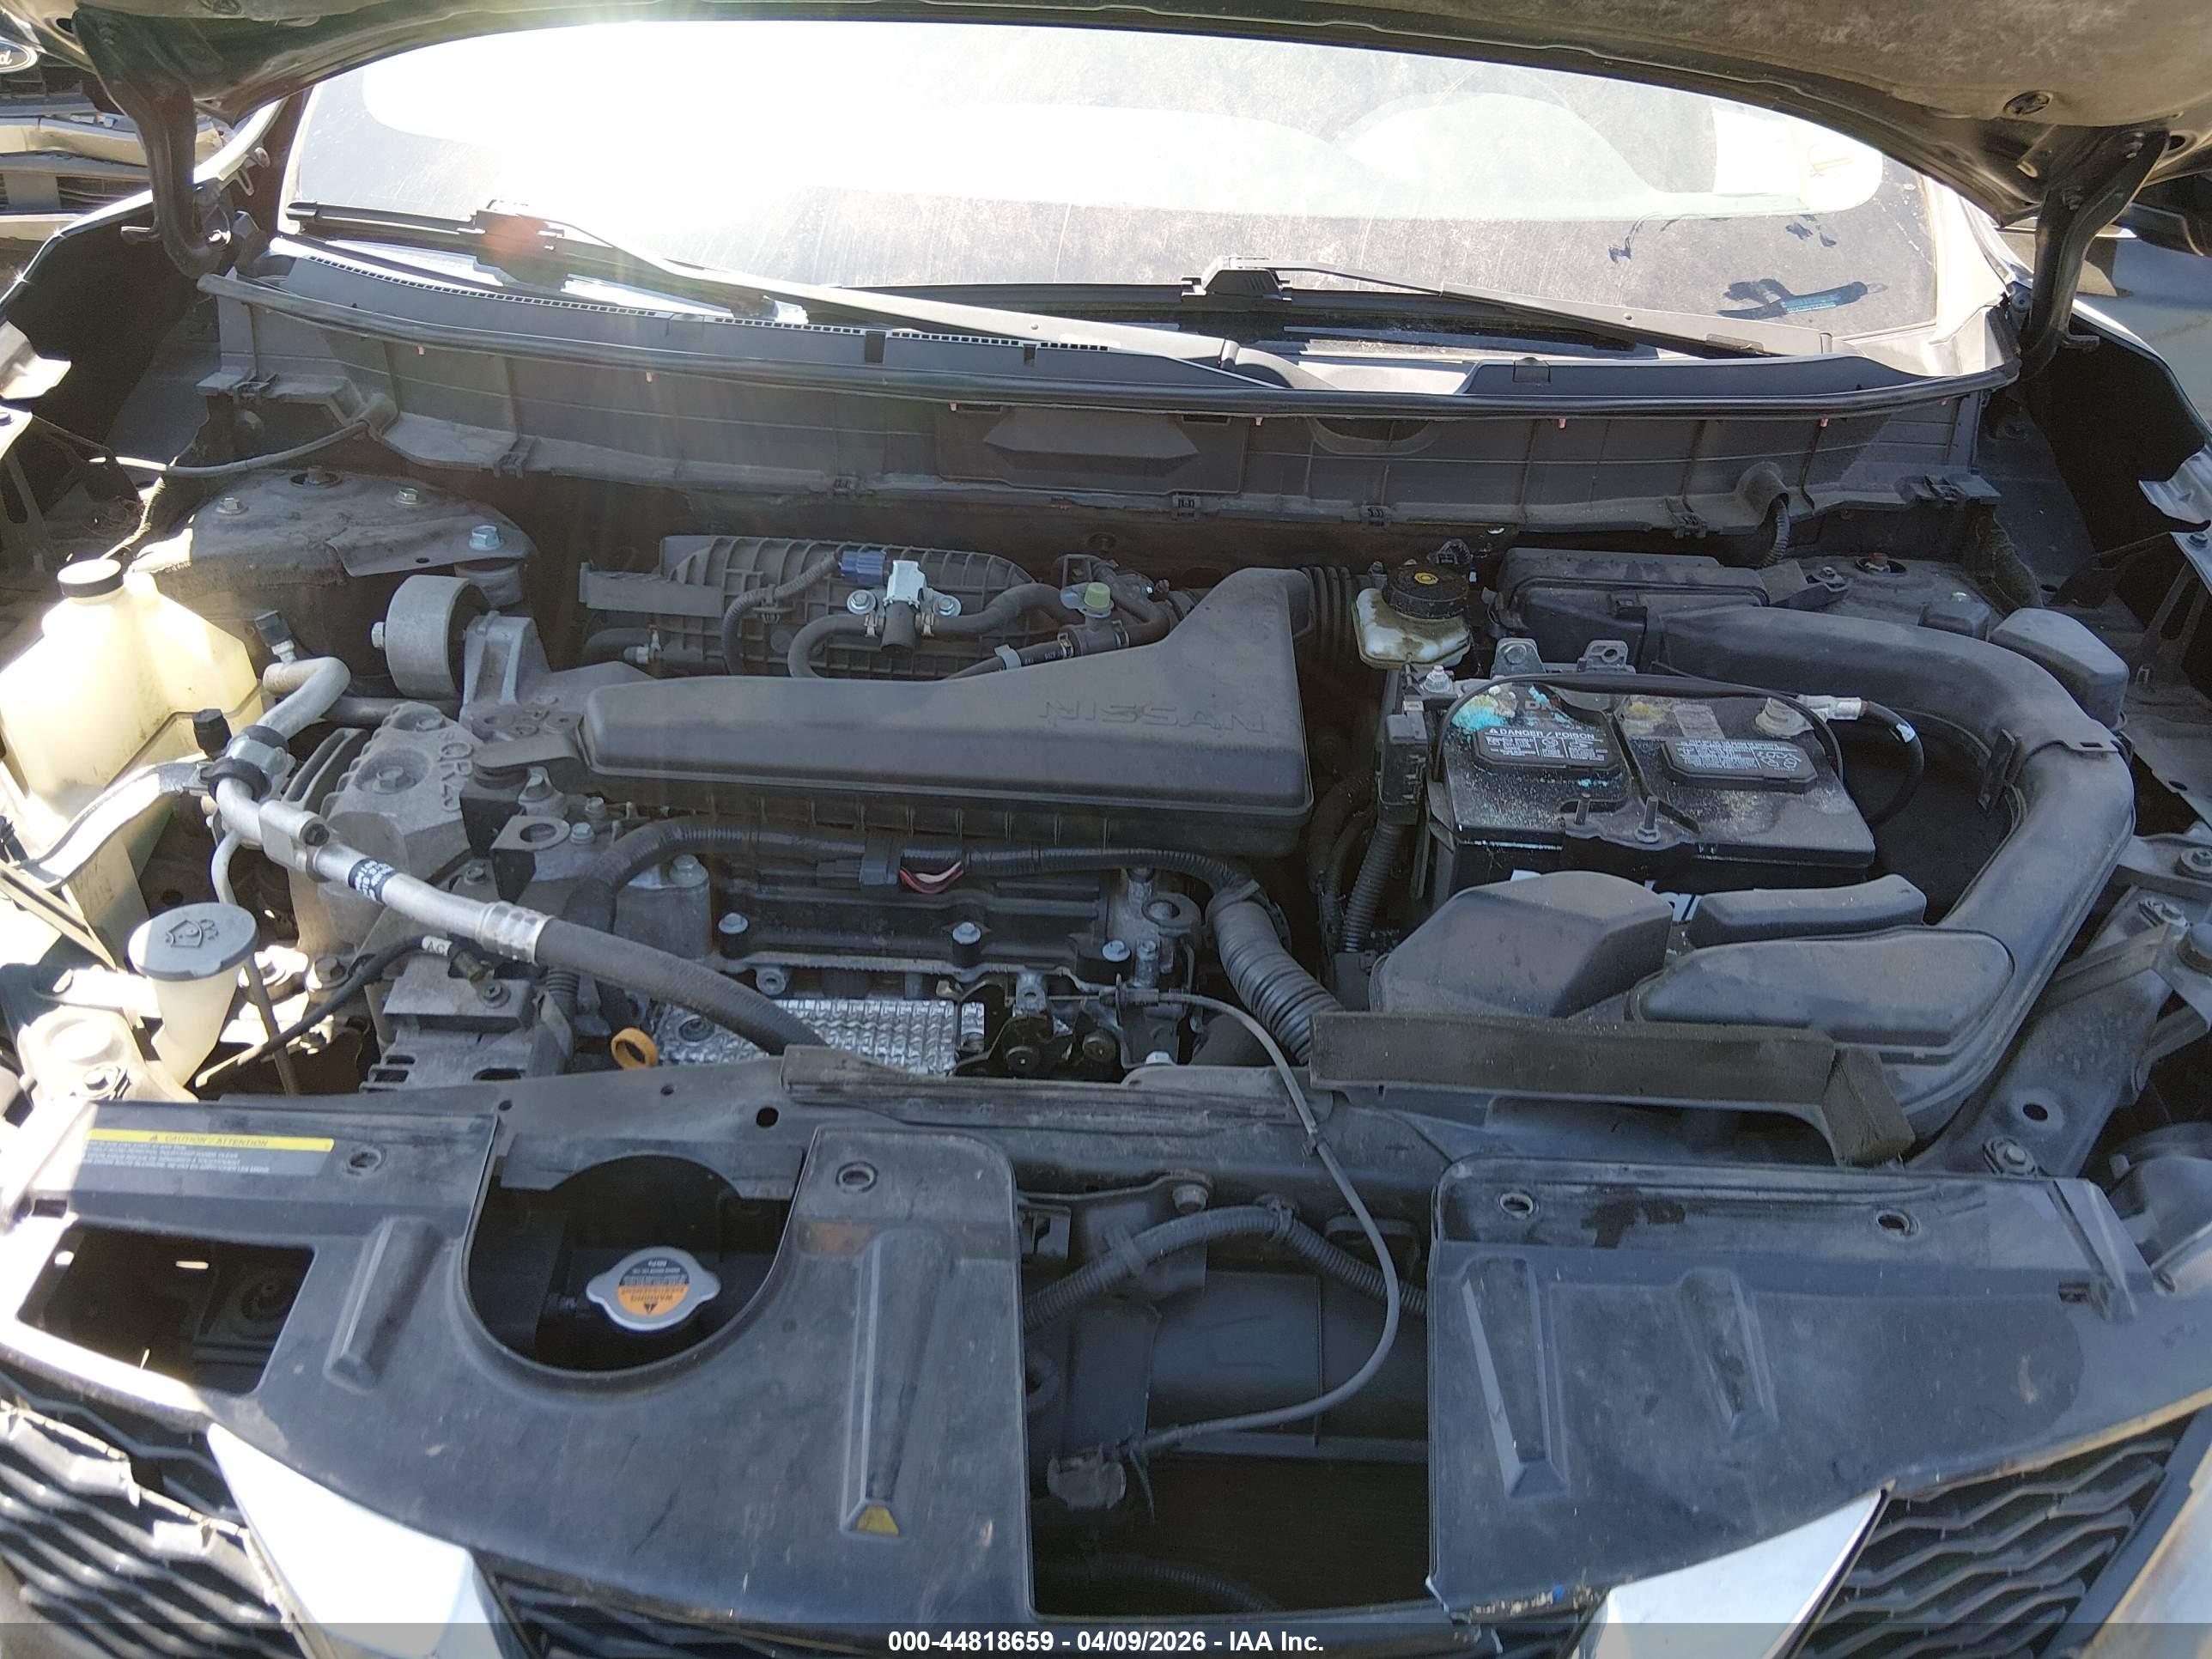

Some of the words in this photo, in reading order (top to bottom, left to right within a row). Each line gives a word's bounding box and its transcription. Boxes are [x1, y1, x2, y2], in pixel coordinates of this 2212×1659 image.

[1038, 701, 1267, 732] NISSAN
[1500, 729, 1544, 738] DANGER
[1555, 732, 1595, 740] POISON
[165, 1134, 208, 1145] CAUTION
[216, 1138, 269, 1147] ATTENTION
